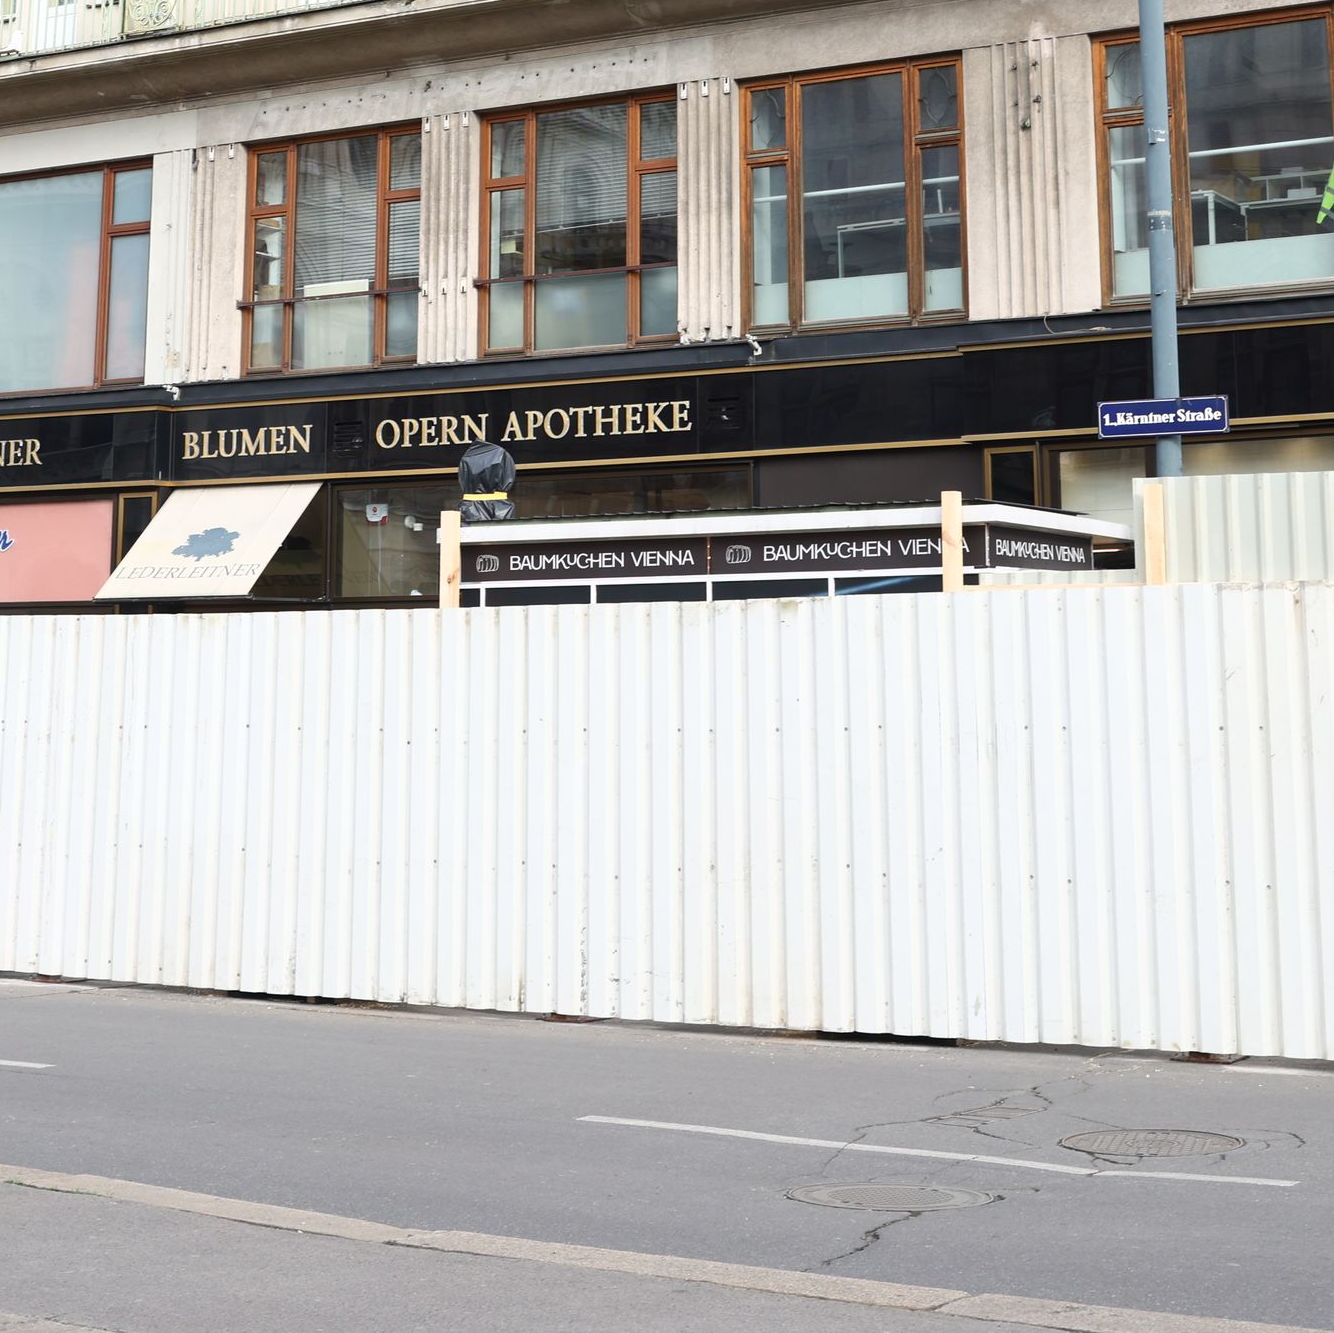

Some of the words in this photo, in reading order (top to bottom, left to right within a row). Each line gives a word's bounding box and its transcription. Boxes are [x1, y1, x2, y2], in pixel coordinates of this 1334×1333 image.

[375, 413, 489, 449] OPERN
[500, 400, 693, 442] APOTHEKE
[1115, 412, 1175, 426] Kärntner
[1177, 407, 1222, 422] Straße
[183, 424, 314, 460] BLUMEN
[509, 552, 625, 571] BAUMKUCHEN
[630, 549, 695, 567] VIENNA
[763, 540, 891, 562] BAUMKUCHEN
[897, 537, 970, 556] VIENA
[995, 538, 1054, 560] BAUMKUCHEN
[1055, 545, 1086, 563] VIENNA
[115, 563, 261, 580] LEDERLEITNER
